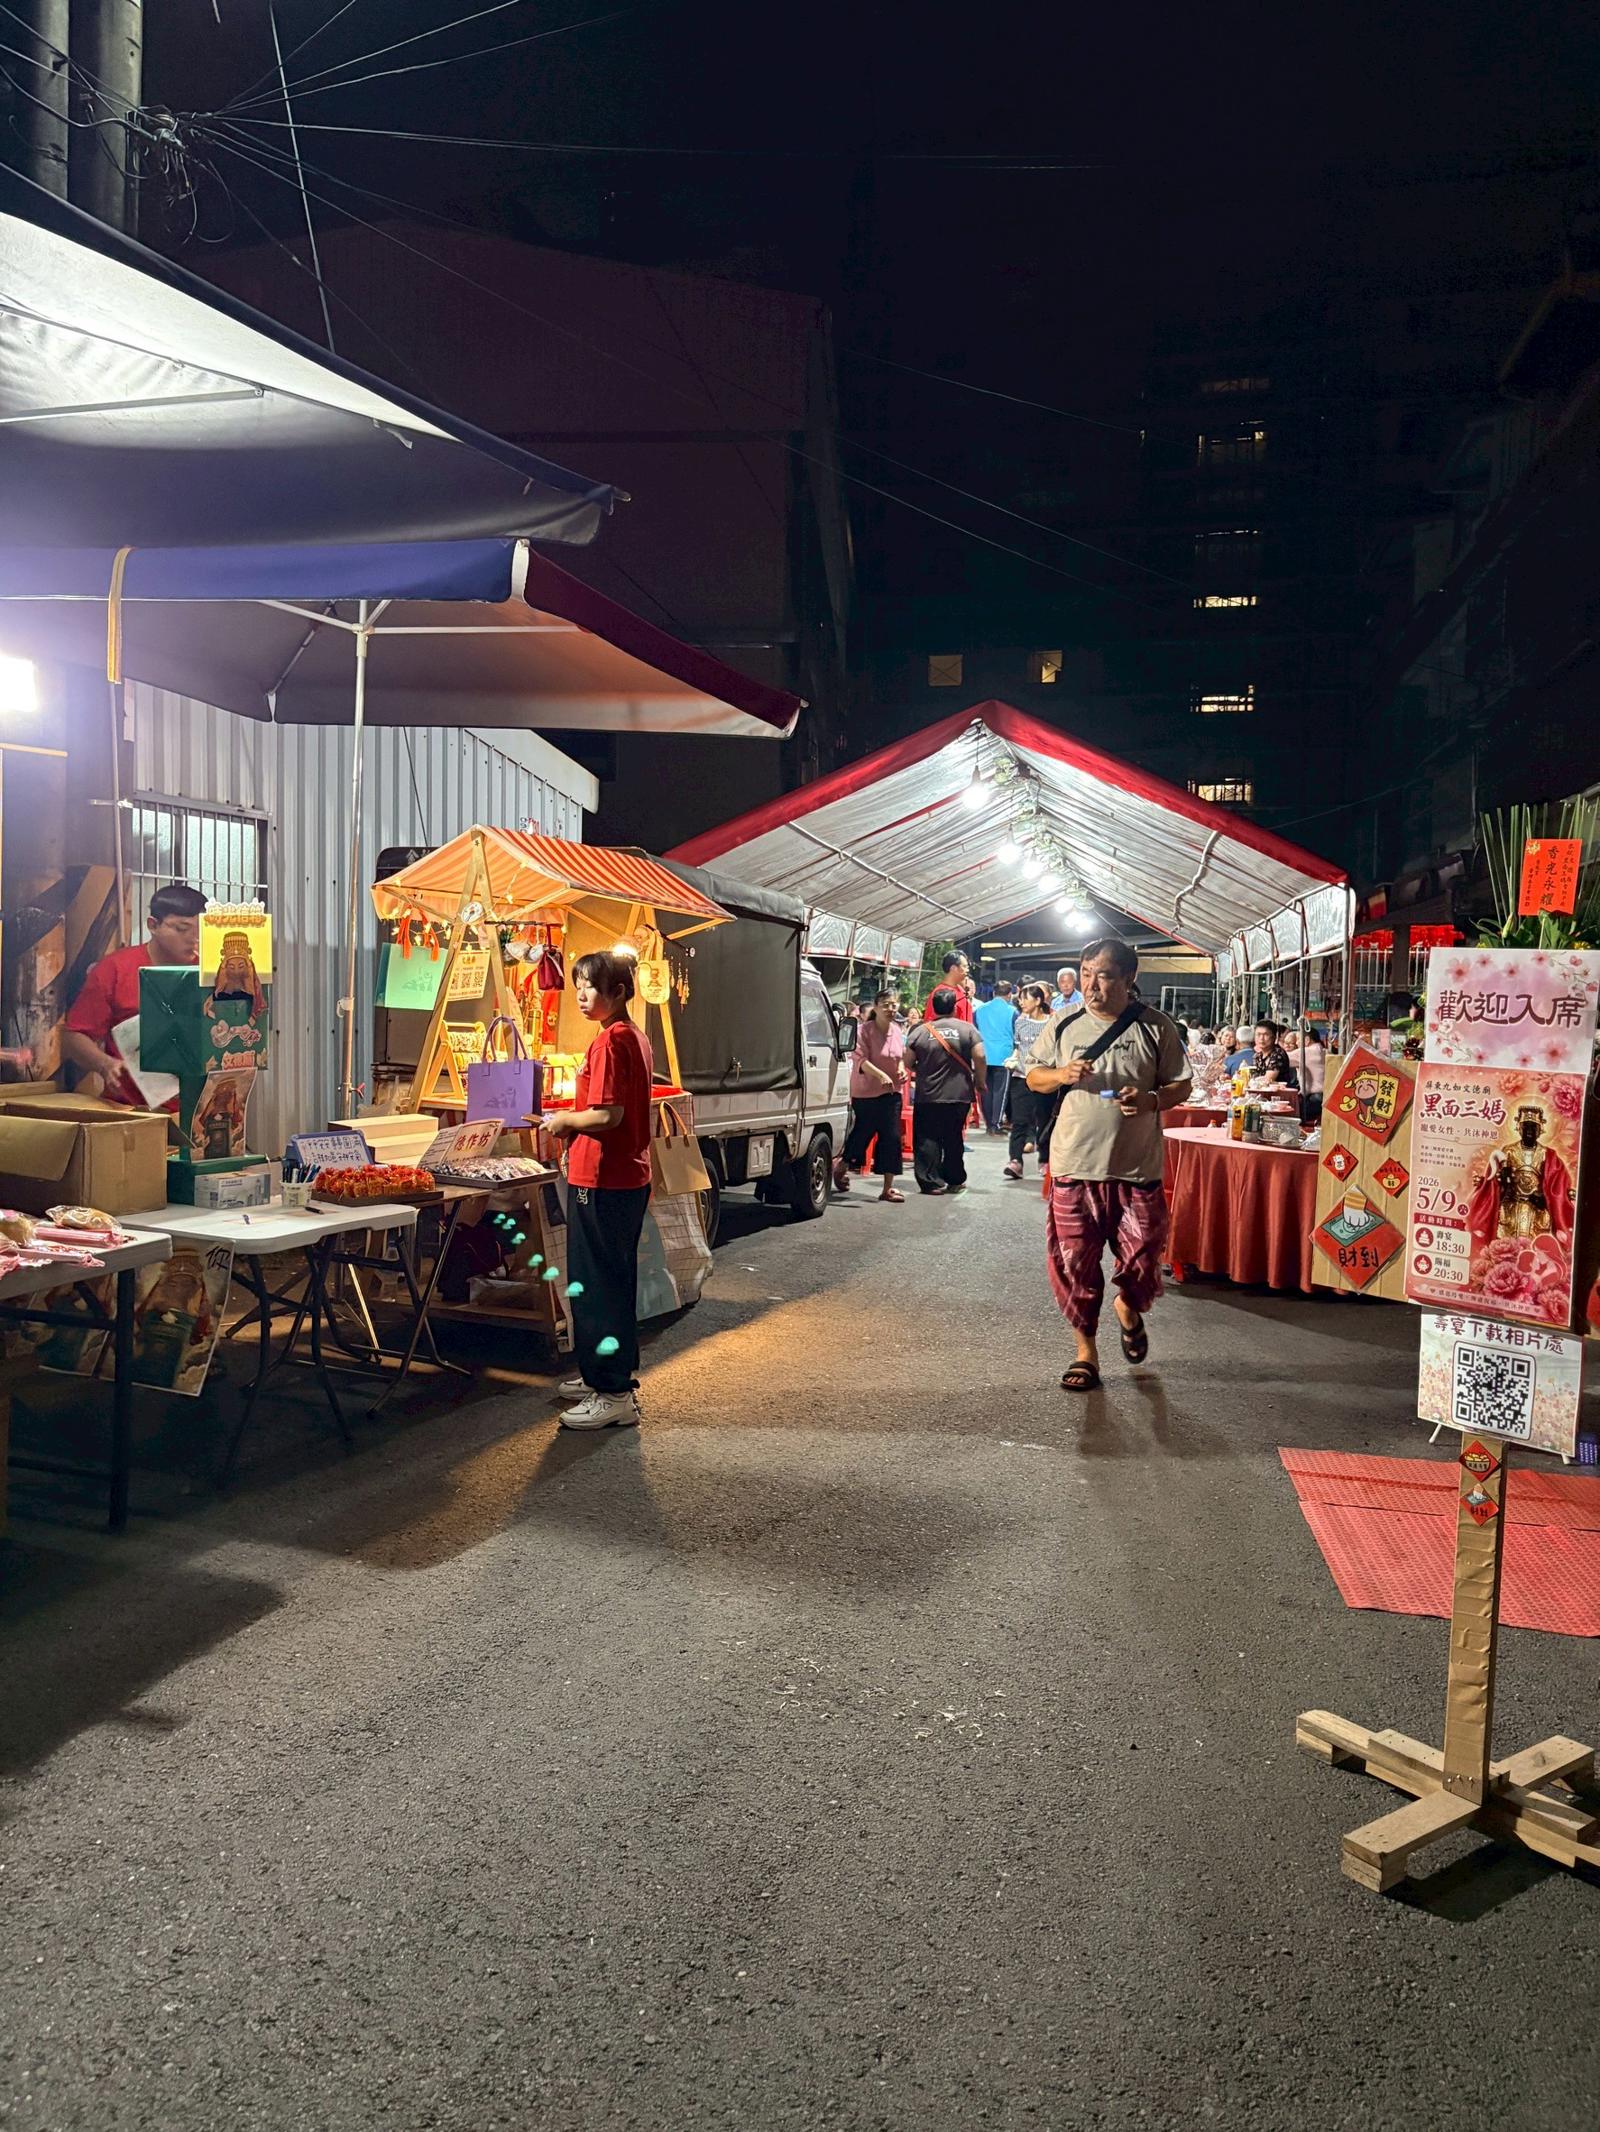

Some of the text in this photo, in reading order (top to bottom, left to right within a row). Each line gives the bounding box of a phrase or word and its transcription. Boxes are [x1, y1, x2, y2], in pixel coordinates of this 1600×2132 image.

[1438, 989, 1588, 1029] 歡迎入席
[1376, 1079, 1395, 1115] 發財
[1420, 1094, 1507, 1126] 黑面三媽
[1418, 1176, 1439, 1187] 2026
[1416, 1187, 1456, 1213] 5/9
[1338, 1247, 1379, 1268] 財到
[1436, 1240, 1465, 1255] 18:30
[1433, 1267, 1463, 1281] 20:30
[1434, 1316, 1565, 1355] 壽宴下載相片處
